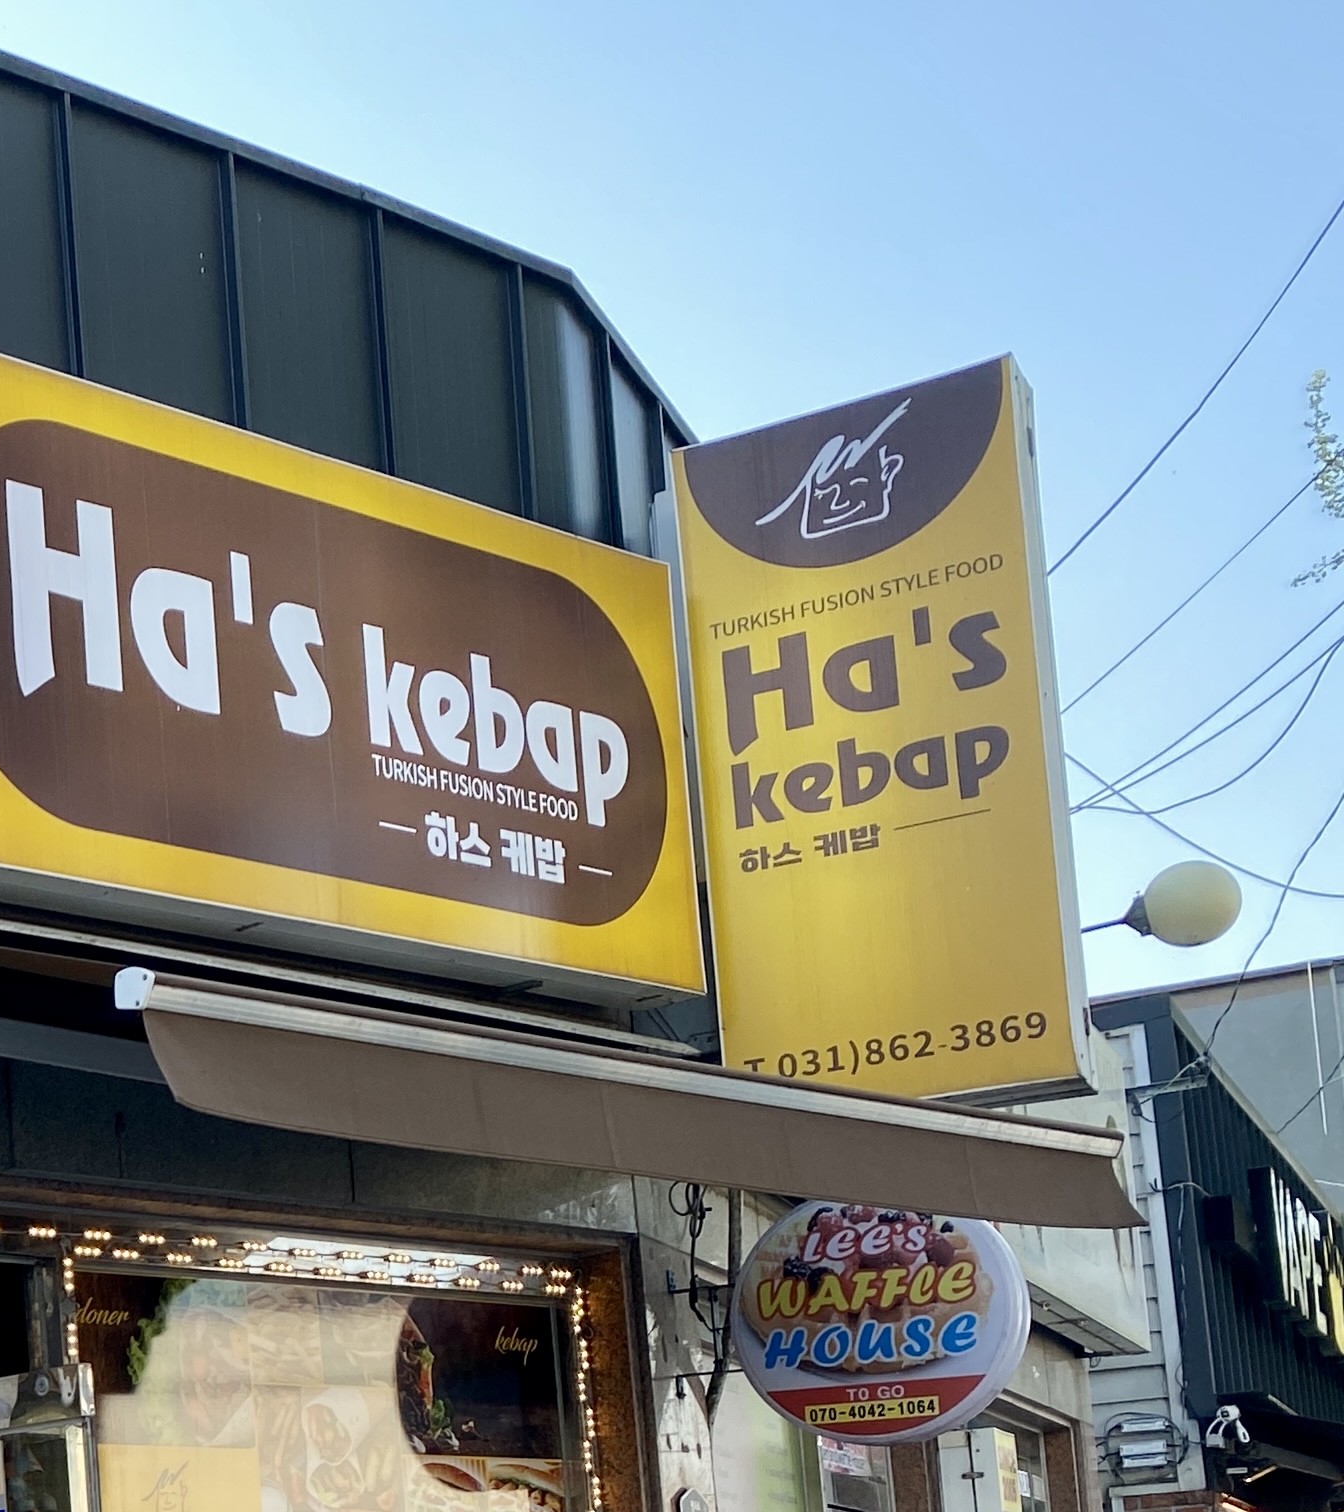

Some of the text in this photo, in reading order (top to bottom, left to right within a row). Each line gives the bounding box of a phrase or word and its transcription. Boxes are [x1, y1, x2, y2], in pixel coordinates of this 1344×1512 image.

[709, 553, 1005, 641] TURKISH FUSION STYLE FOOD
[5, 478, 629, 828] Ha's kebap
[721, 605, 1009, 756] Ha's
[371, 752, 579, 822] TURKISH FUSION STYLE FOOD
[730, 724, 1011, 830] kebap
[424, 810, 567, 885] 하스 케밥
[738, 823, 882, 874] 하스 케밥
[743, 1011, 1047, 1078] T031)862-3869
[494, 1326, 539, 1366] kebap
[764, 1312, 979, 1370] HOUSE
[808, 1399, 937, 1423] 070-4042-1064
[845, 1384, 905, 1402] TO GO
